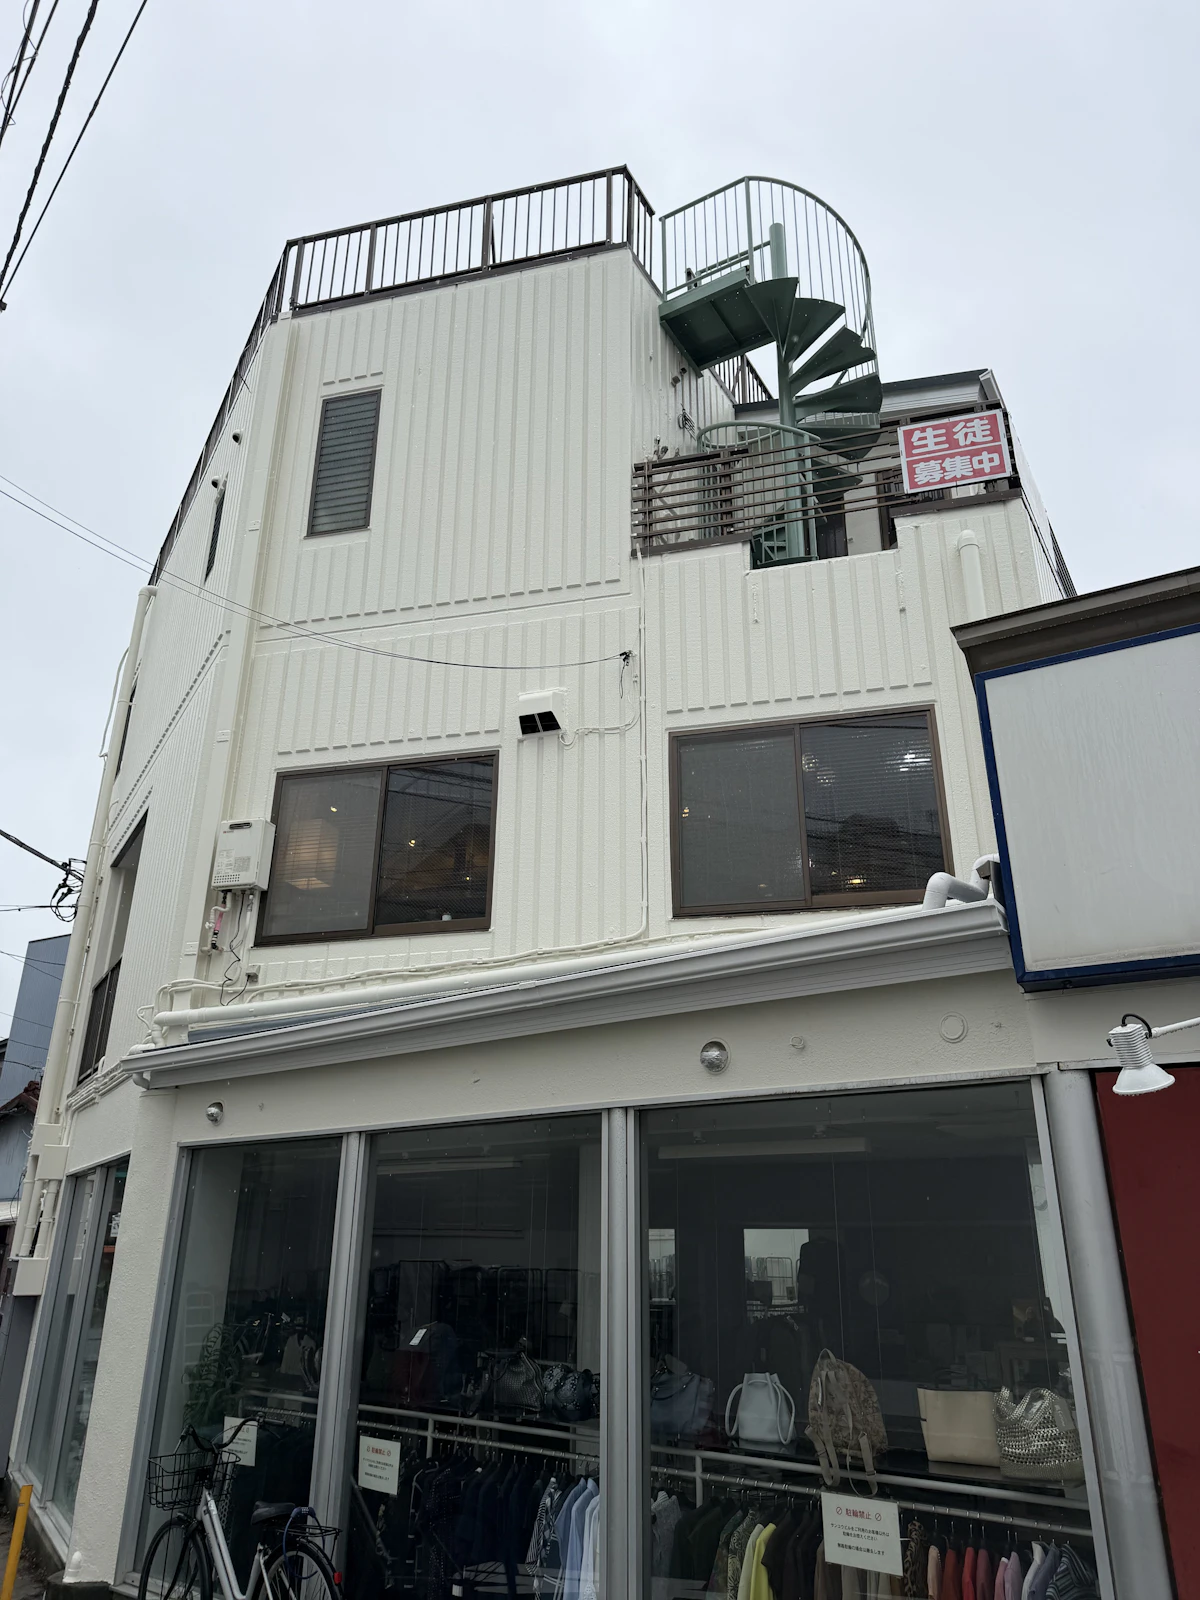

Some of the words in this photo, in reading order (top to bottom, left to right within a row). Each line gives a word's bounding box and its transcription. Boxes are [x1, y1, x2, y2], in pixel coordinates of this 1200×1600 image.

[911, 419, 993, 454] 生徒
[913, 451, 1000, 485] 募集中
[845, 1508, 872, 1520] 駐輪禁止
